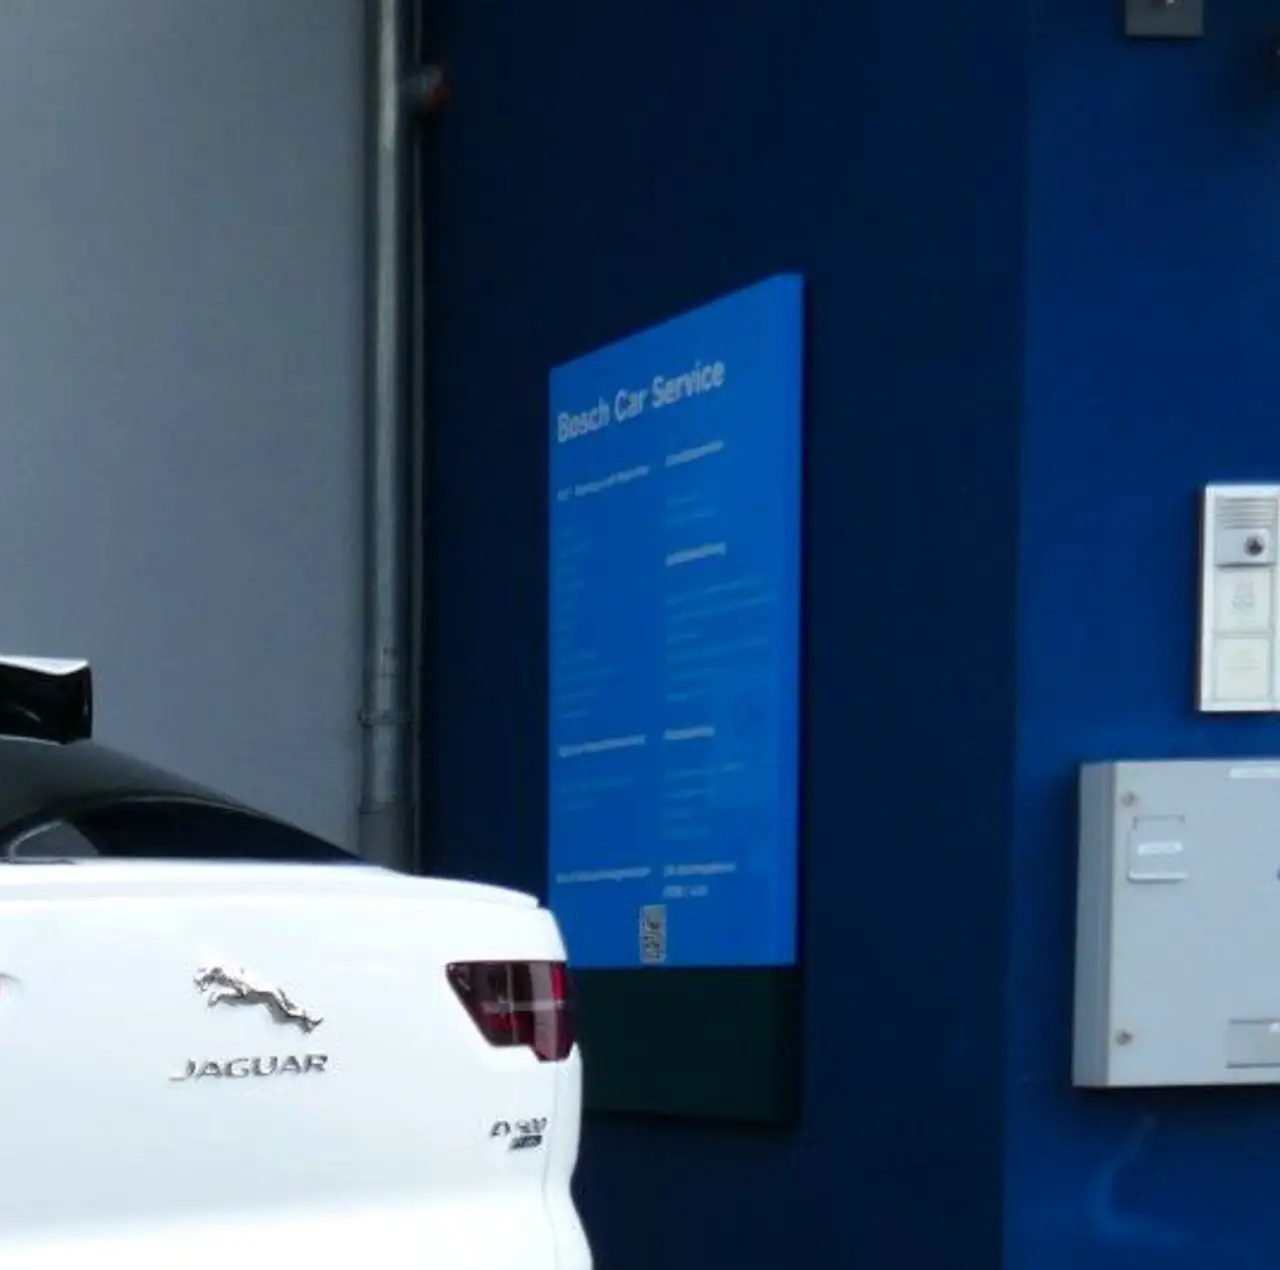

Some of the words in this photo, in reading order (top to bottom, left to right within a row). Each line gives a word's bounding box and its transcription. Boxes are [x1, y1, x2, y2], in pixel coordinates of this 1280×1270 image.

[557, 397, 610, 443] Bosch
[614, 388, 648, 422] Car
[652, 360, 726, 408] Service
[168, 1053, 329, 1082] JAGUAR
